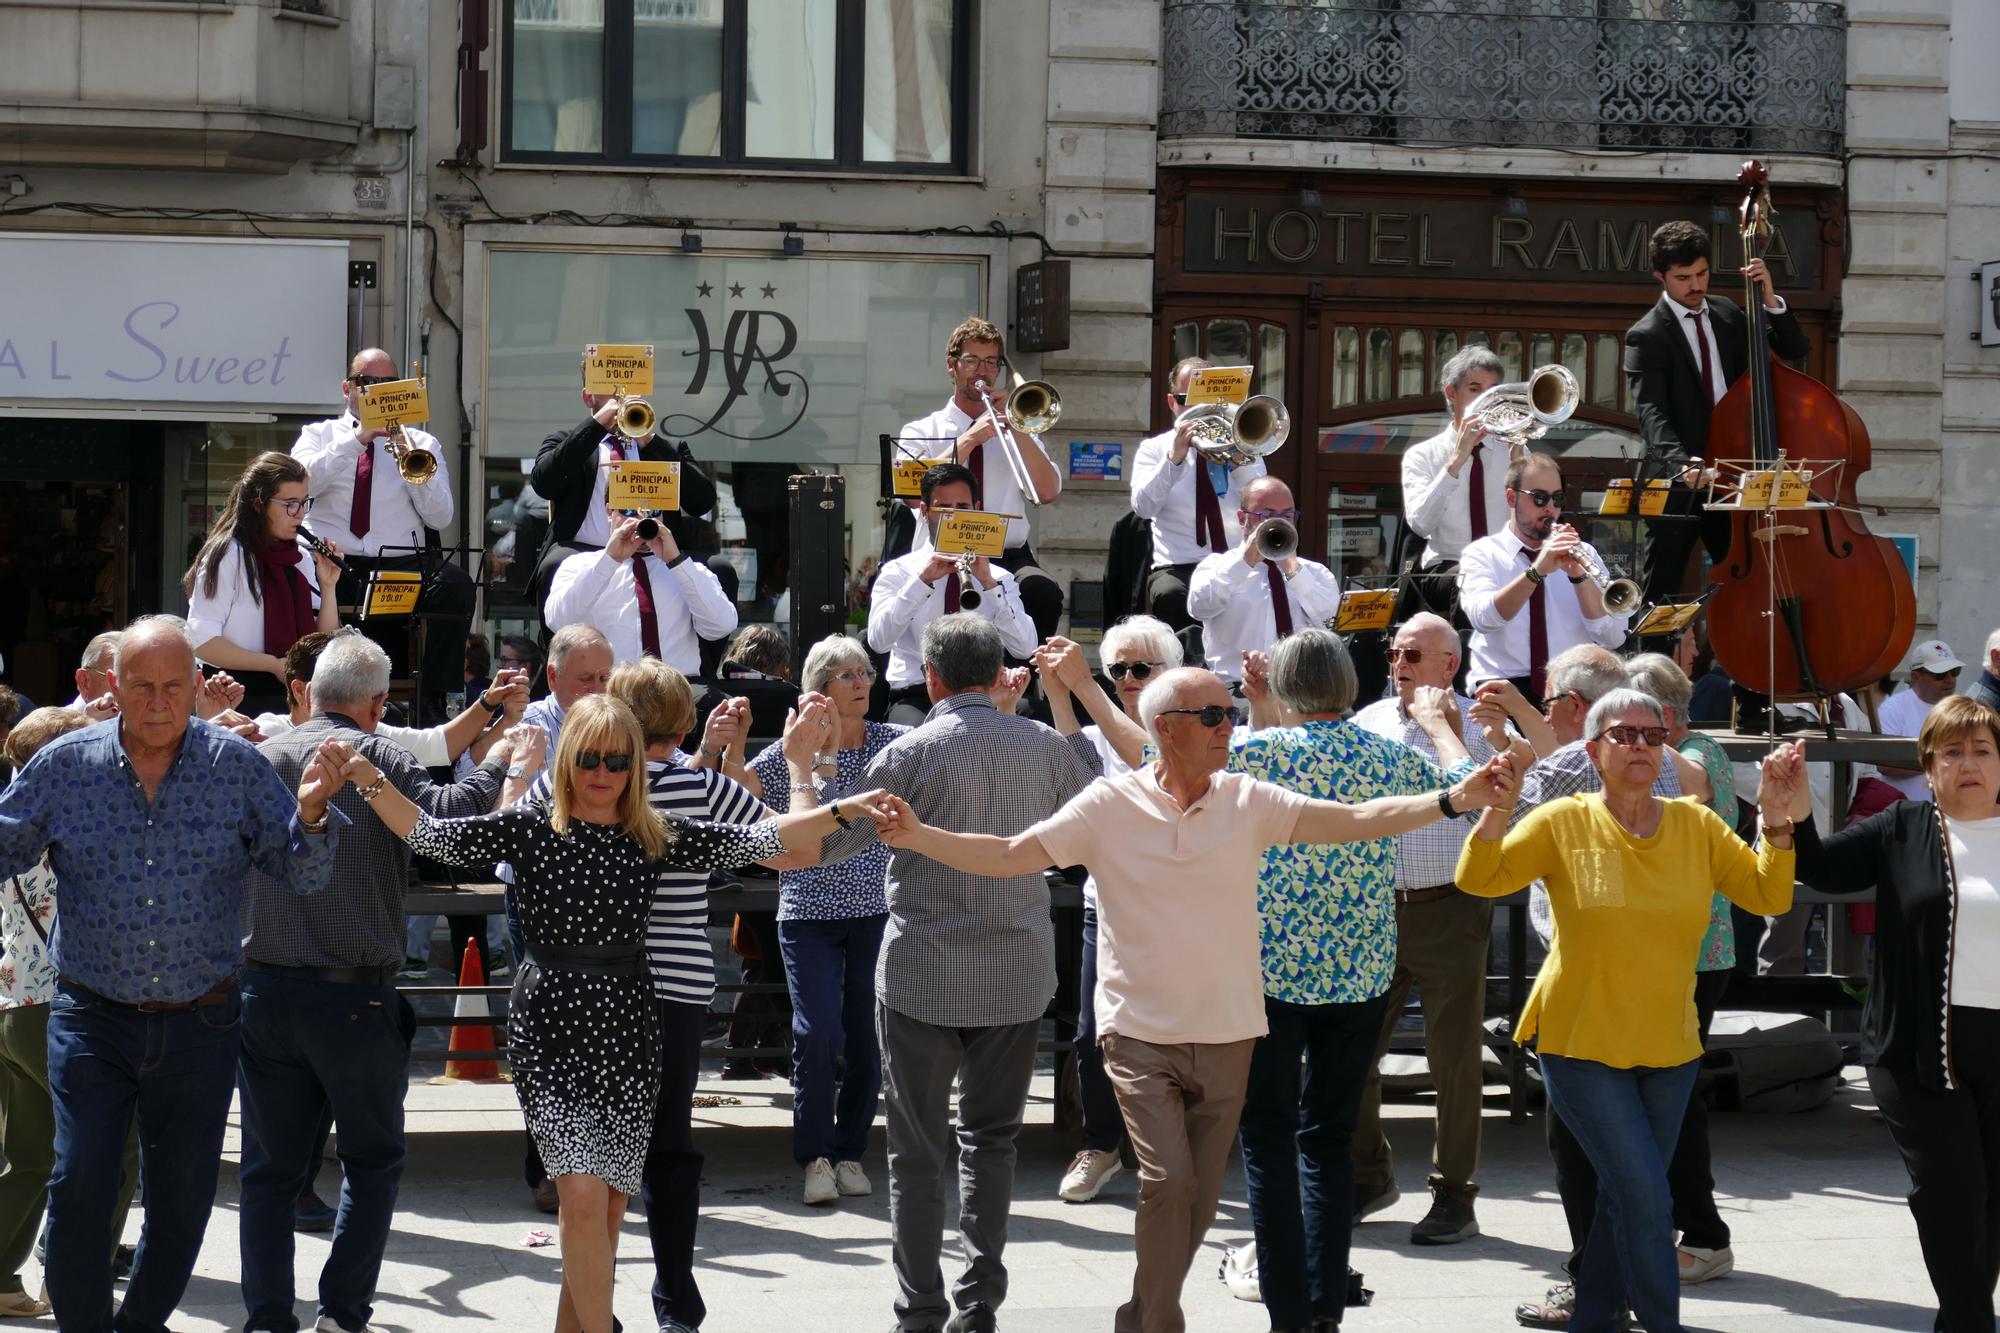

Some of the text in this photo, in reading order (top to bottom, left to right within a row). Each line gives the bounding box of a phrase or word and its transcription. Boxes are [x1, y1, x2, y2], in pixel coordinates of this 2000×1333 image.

[361, 180, 384, 199] 35
[1214, 207, 1800, 278] HOTEL RAMLA
[104, 301, 292, 386] Sweet
[592, 359, 648, 369] LA PRINCIPAL
[606, 370, 634, 379] D'OLOT
[1208, 377, 1245, 385] PRINCIPAL
[365, 398, 377, 407] LA
[379, 391, 422, 405] PRINCIPAL
[380, 402, 409, 414] D'OLOT
[898, 470, 910, 478] LA
[616, 474, 673, 485] LA PRINCIPAL
[630, 485, 659, 494] D'OLOT
[946, 522, 957, 530] LA
[960, 523, 1000, 534] PRINCIPAL
[958, 531, 986, 541] D'OLOT
[383, 585, 417, 594] PRINCIPAL
[381, 594, 403, 602] D'OLOT
